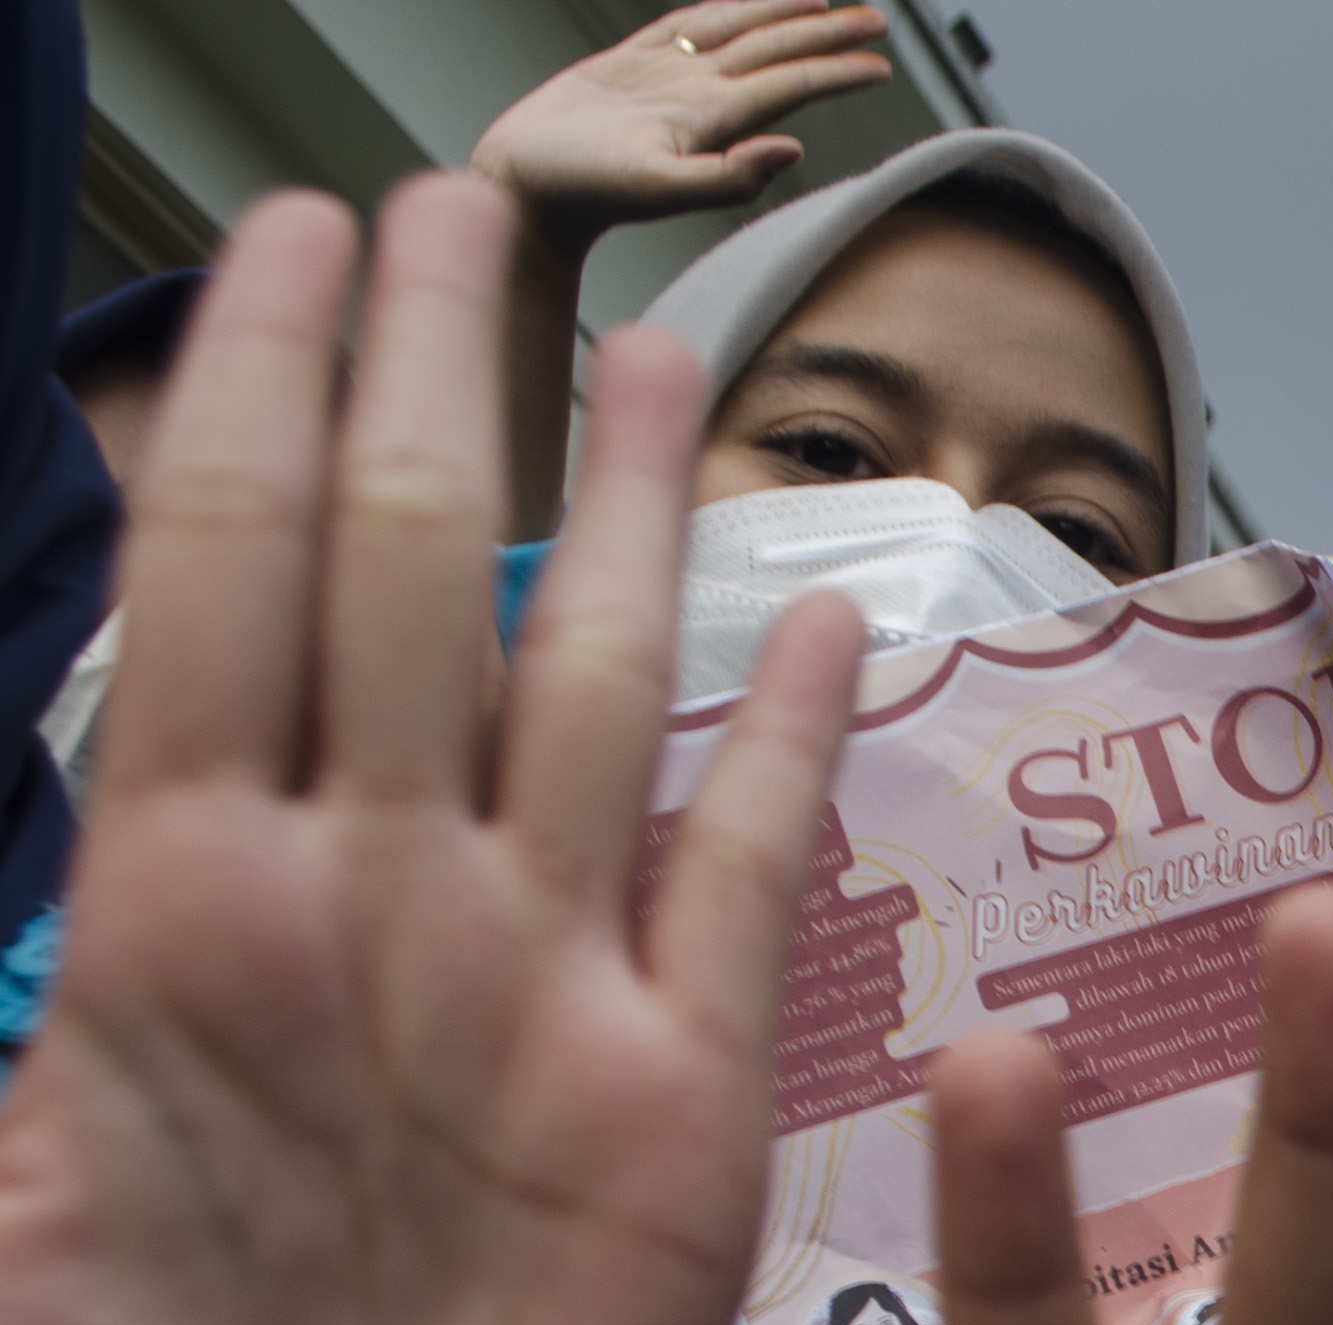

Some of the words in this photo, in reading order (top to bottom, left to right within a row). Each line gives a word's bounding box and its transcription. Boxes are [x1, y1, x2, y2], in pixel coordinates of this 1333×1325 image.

[809, 892, 911, 946] Menengah
[992, 955, 1093, 1000] Sementara
[1092, 928, 1172, 971] laki-laki
[1171, 918, 1220, 954] yang
[1072, 968, 1154, 1010] dibawah
[1156, 965, 1178, 985] 18
[1178, 944, 1235, 978] tahun
[847, 970, 898, 1005] yang
[1041, 1014, 1115, 1059] kannya
[1114, 990, 1199, 1033] dominan
[1199, 974, 1248, 1013] pada
[812, 1041, 881, 1085] hingga
[1098, 1018, 1220, 1073] menamatkan
[791, 1074, 895, 1126] Menengah
[1058, 1085, 1126, 1120] ertama
[1185, 1051, 1224, 1080] dan
